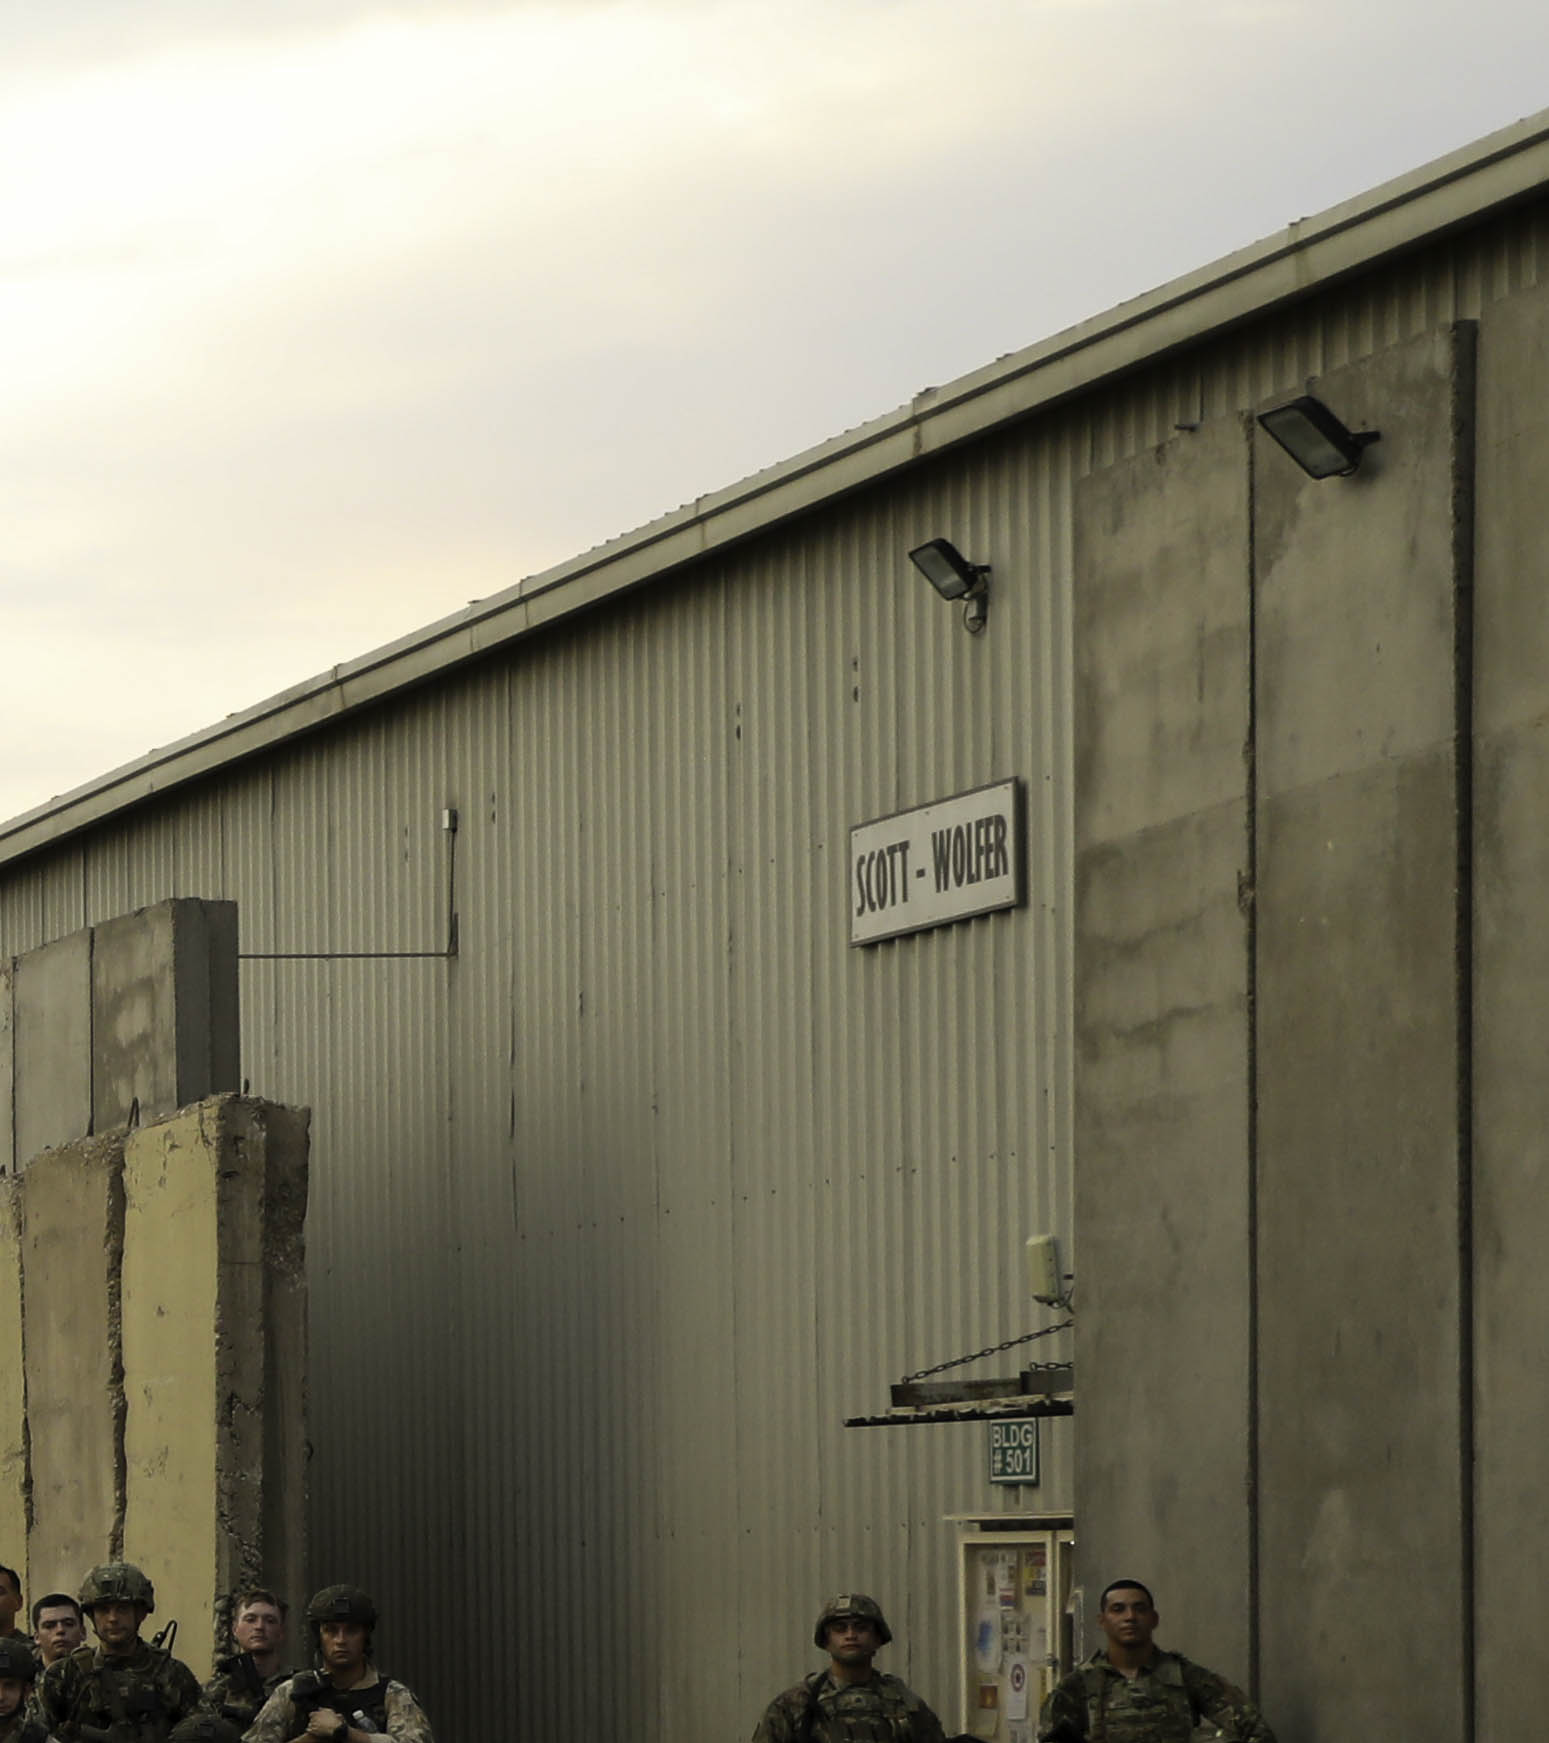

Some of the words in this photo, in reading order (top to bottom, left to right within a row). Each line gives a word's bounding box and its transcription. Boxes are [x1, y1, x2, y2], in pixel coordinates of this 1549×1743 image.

[856, 840, 909, 917] SCOTT
[916, 868, 926, 878] -
[931, 814, 1009, 893] WOLFER
[993, 1424, 1033, 1448] BLDG
[994, 1450, 1002, 1474] #
[1006, 1448, 1031, 1473] 501
